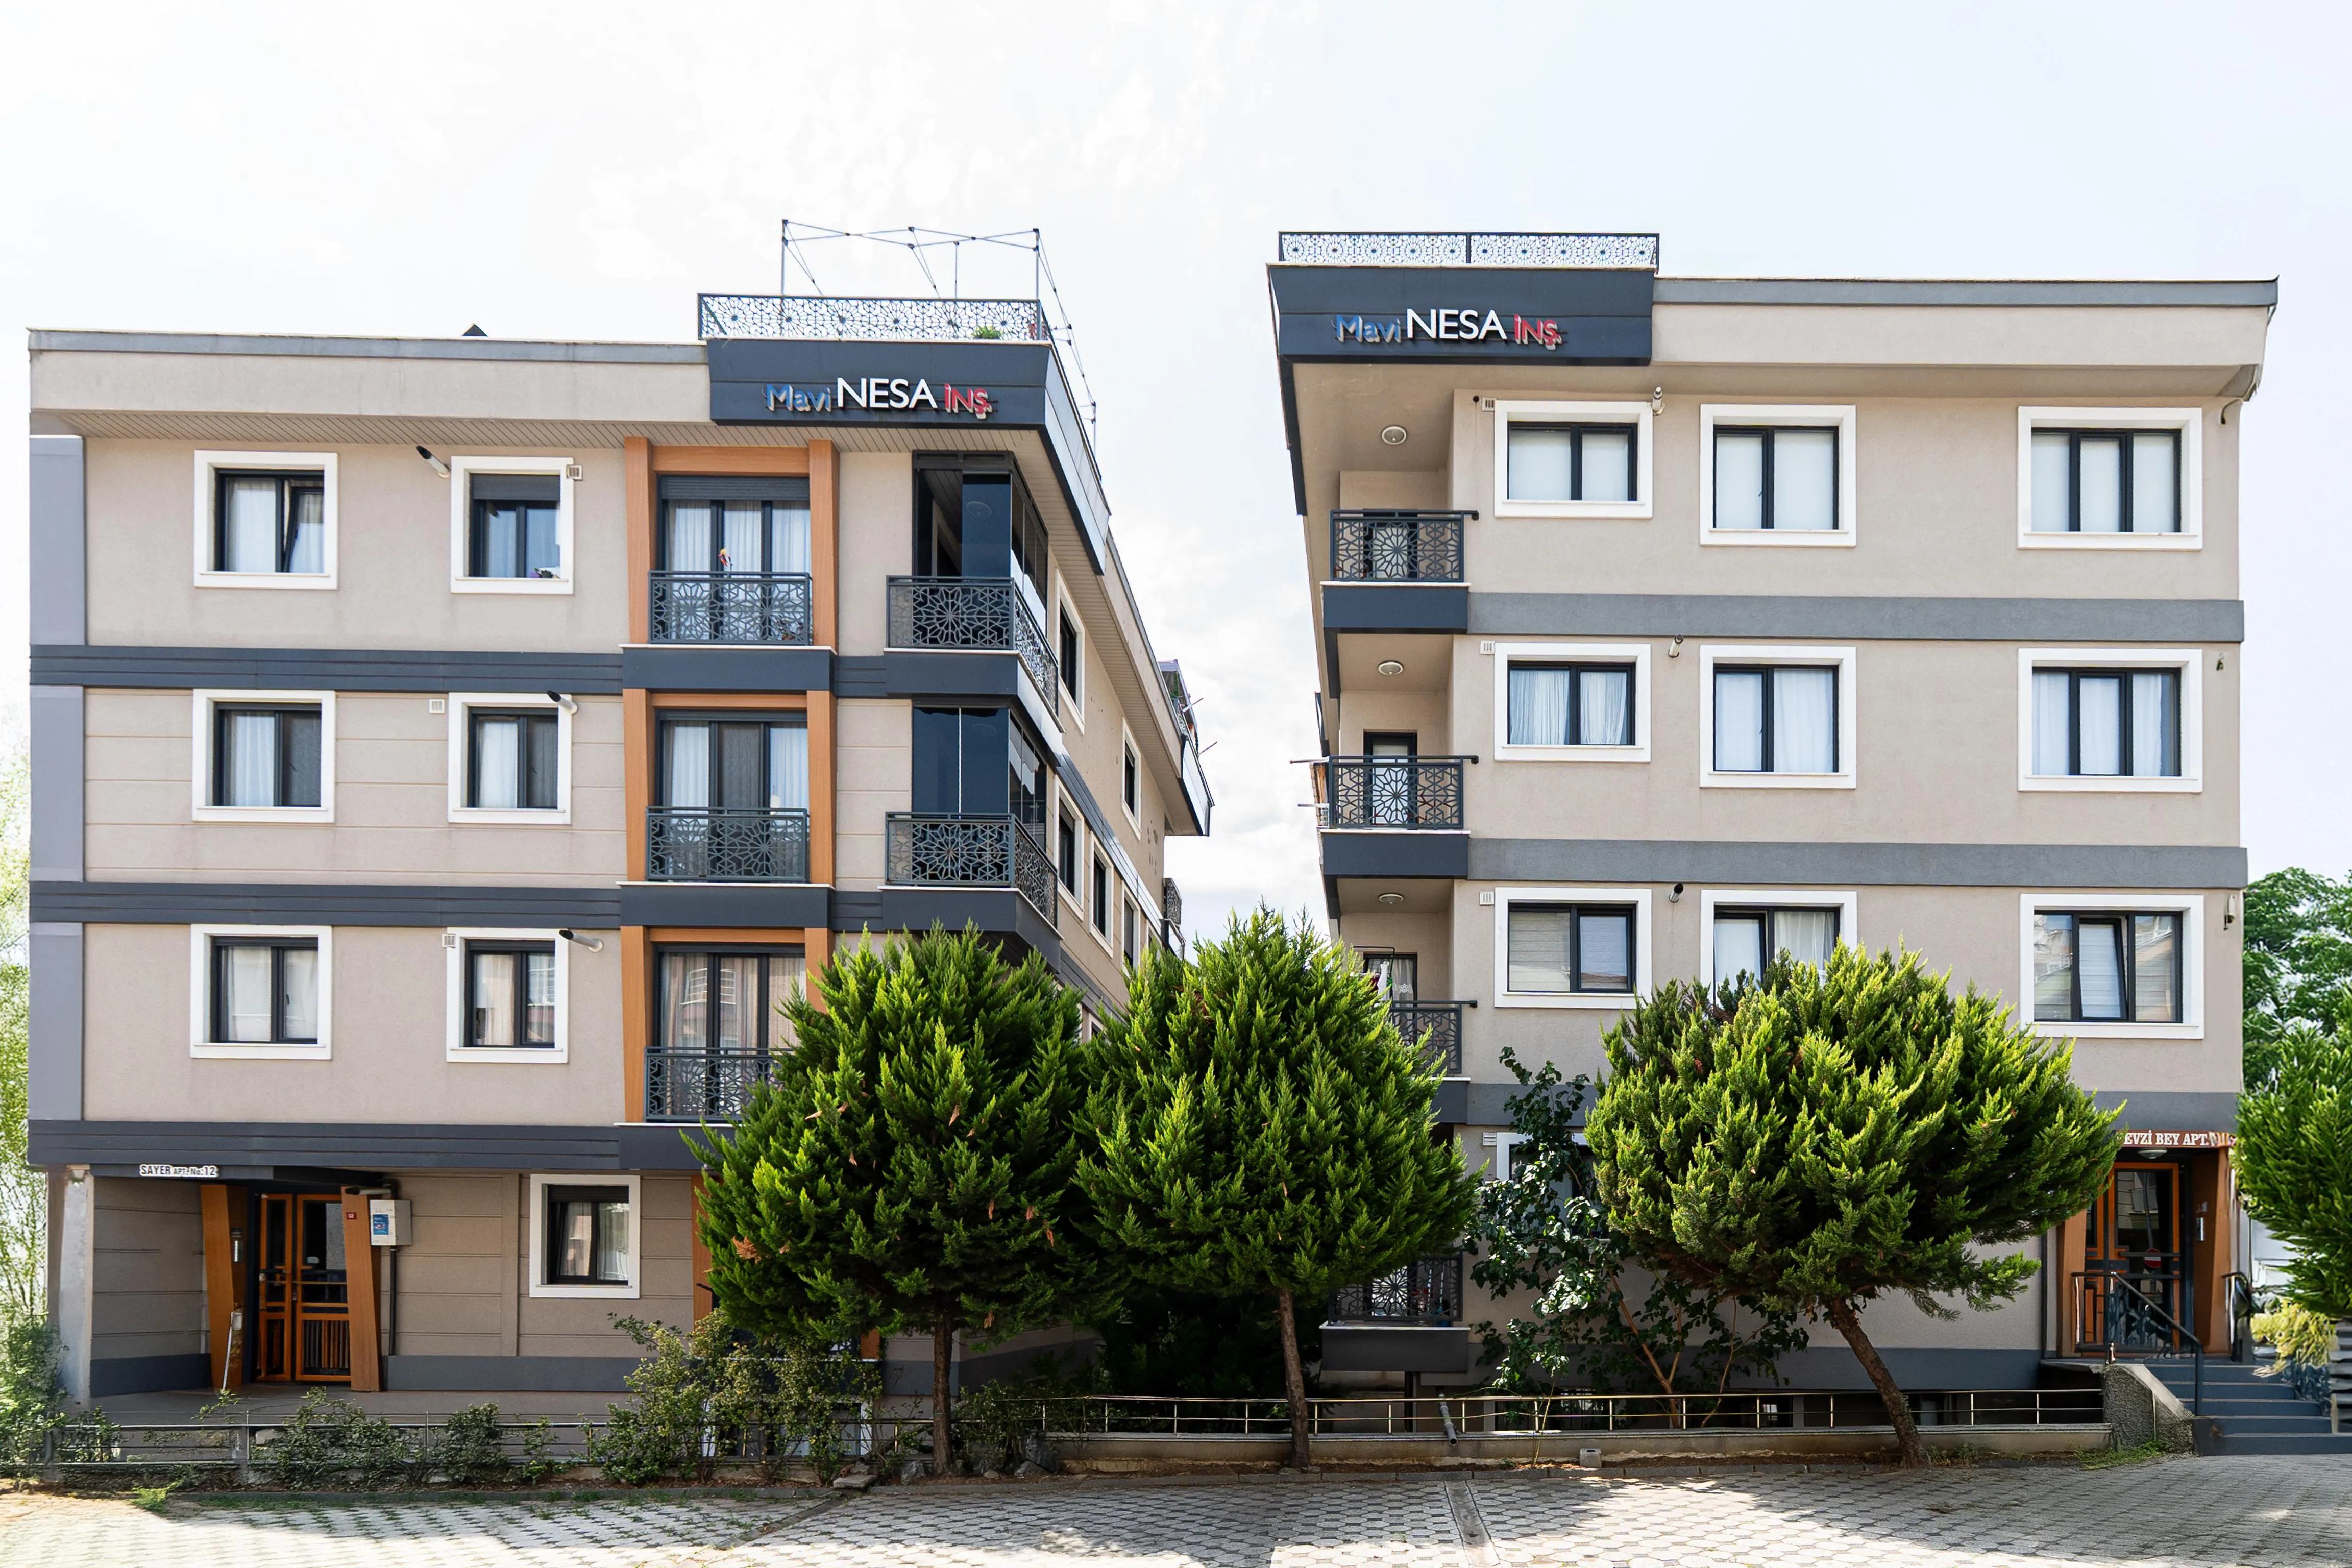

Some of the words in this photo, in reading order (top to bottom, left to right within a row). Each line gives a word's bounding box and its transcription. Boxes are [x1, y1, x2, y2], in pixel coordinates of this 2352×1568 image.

[1335, 314, 1402, 344] Mavi
[1407, 308, 1508, 340] NESA
[766, 383, 832, 412] Mavi
[837, 377, 939, 409] NESA
[2116, 1130, 2153, 1145] EVZİ
[2155, 1133, 2180, 1145] BEY
[2183, 1133, 2209, 1146] APT.
[141, 1165, 171, 1175] SAYER
